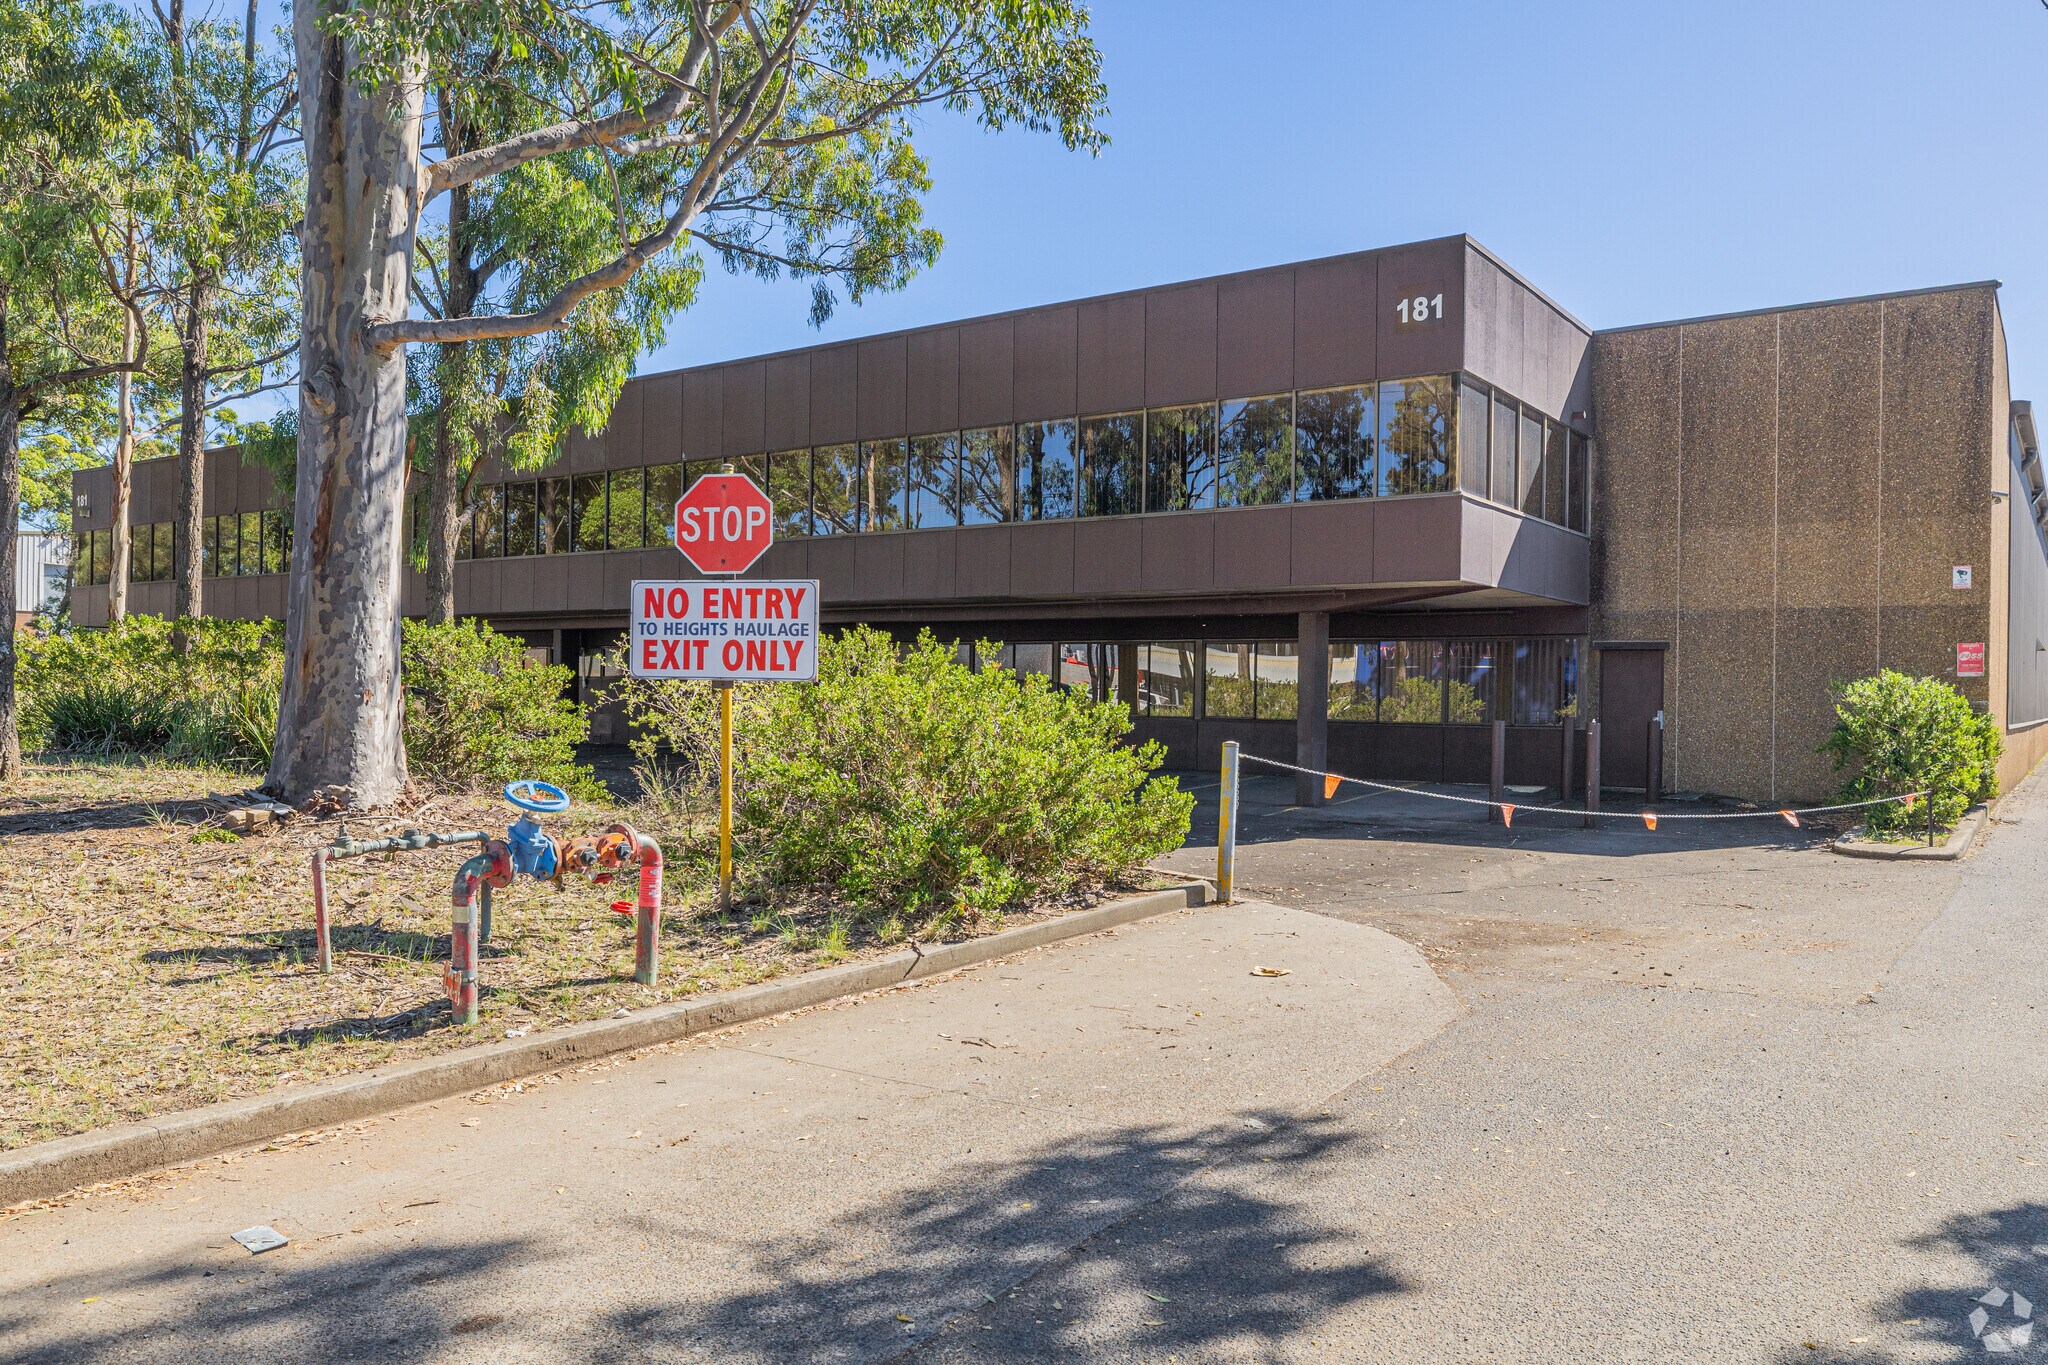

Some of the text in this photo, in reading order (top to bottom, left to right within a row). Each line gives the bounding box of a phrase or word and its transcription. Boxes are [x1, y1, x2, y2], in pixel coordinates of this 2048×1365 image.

[1397, 294, 1443, 323] 181
[77, 494, 88, 507] 181
[681, 505, 766, 542] STOP
[644, 588, 807, 619] NO ENTRY
[638, 622, 809, 637] TO HEIGHTS HAULAGE
[642, 639, 804, 672] EXIT ONLY
